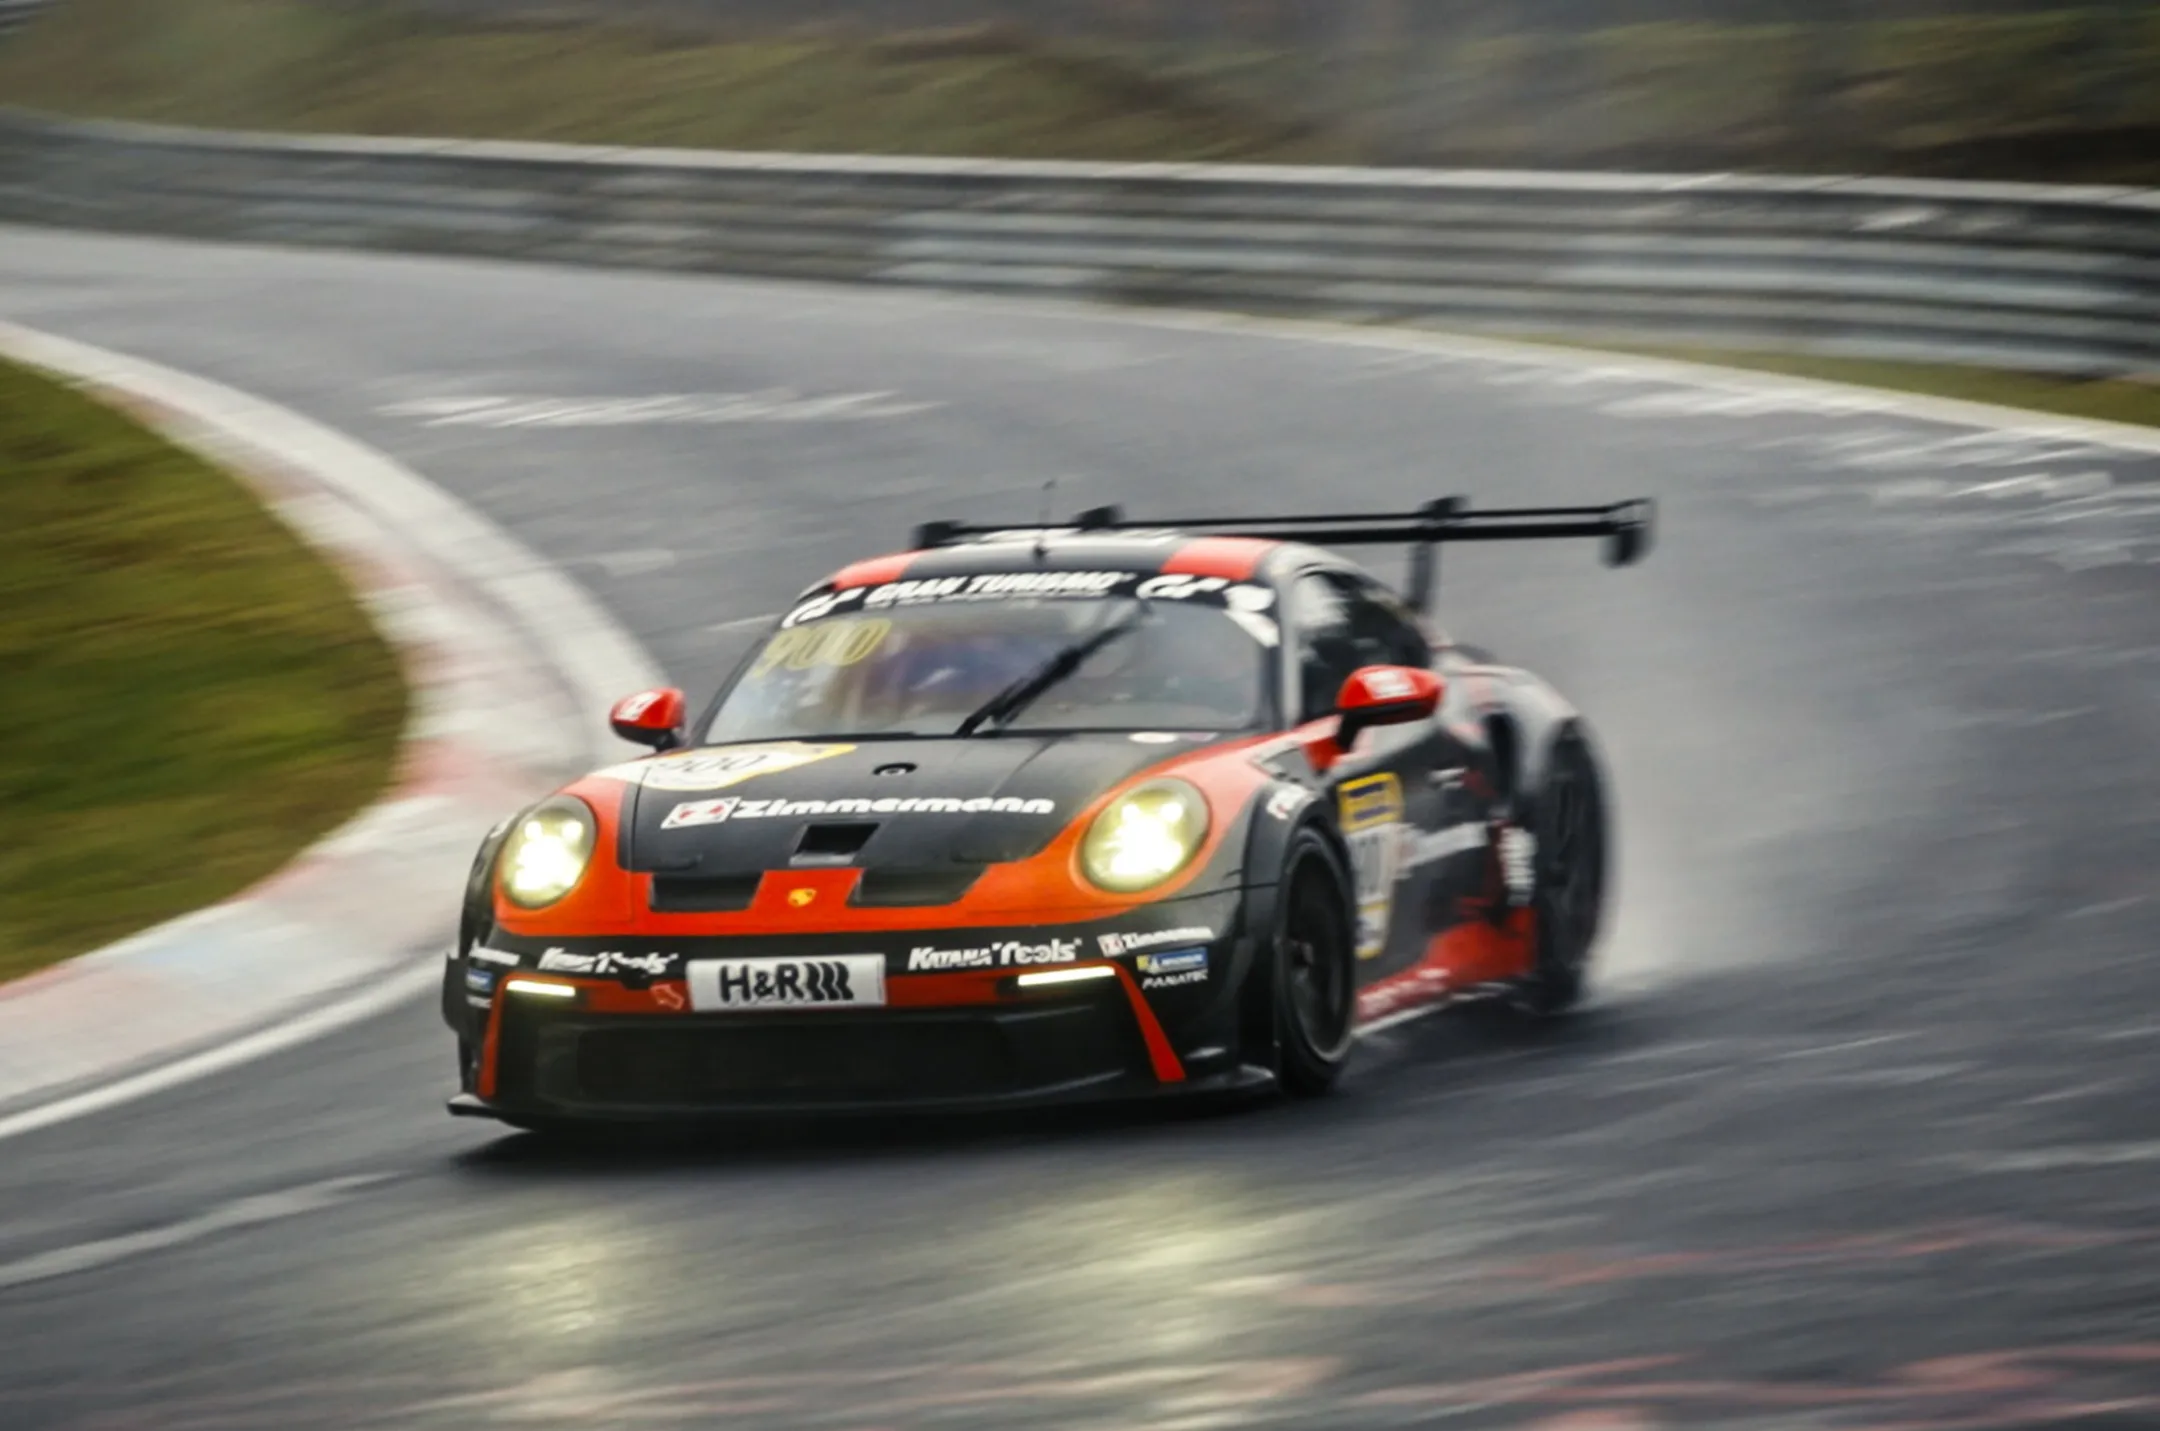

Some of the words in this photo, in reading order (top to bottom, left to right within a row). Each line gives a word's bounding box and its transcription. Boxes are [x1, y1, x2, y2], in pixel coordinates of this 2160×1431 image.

[752, 617, 892, 678] 900
[731, 798, 1056, 819] Zimmermann
[719, 962, 804, 1002] H&R
